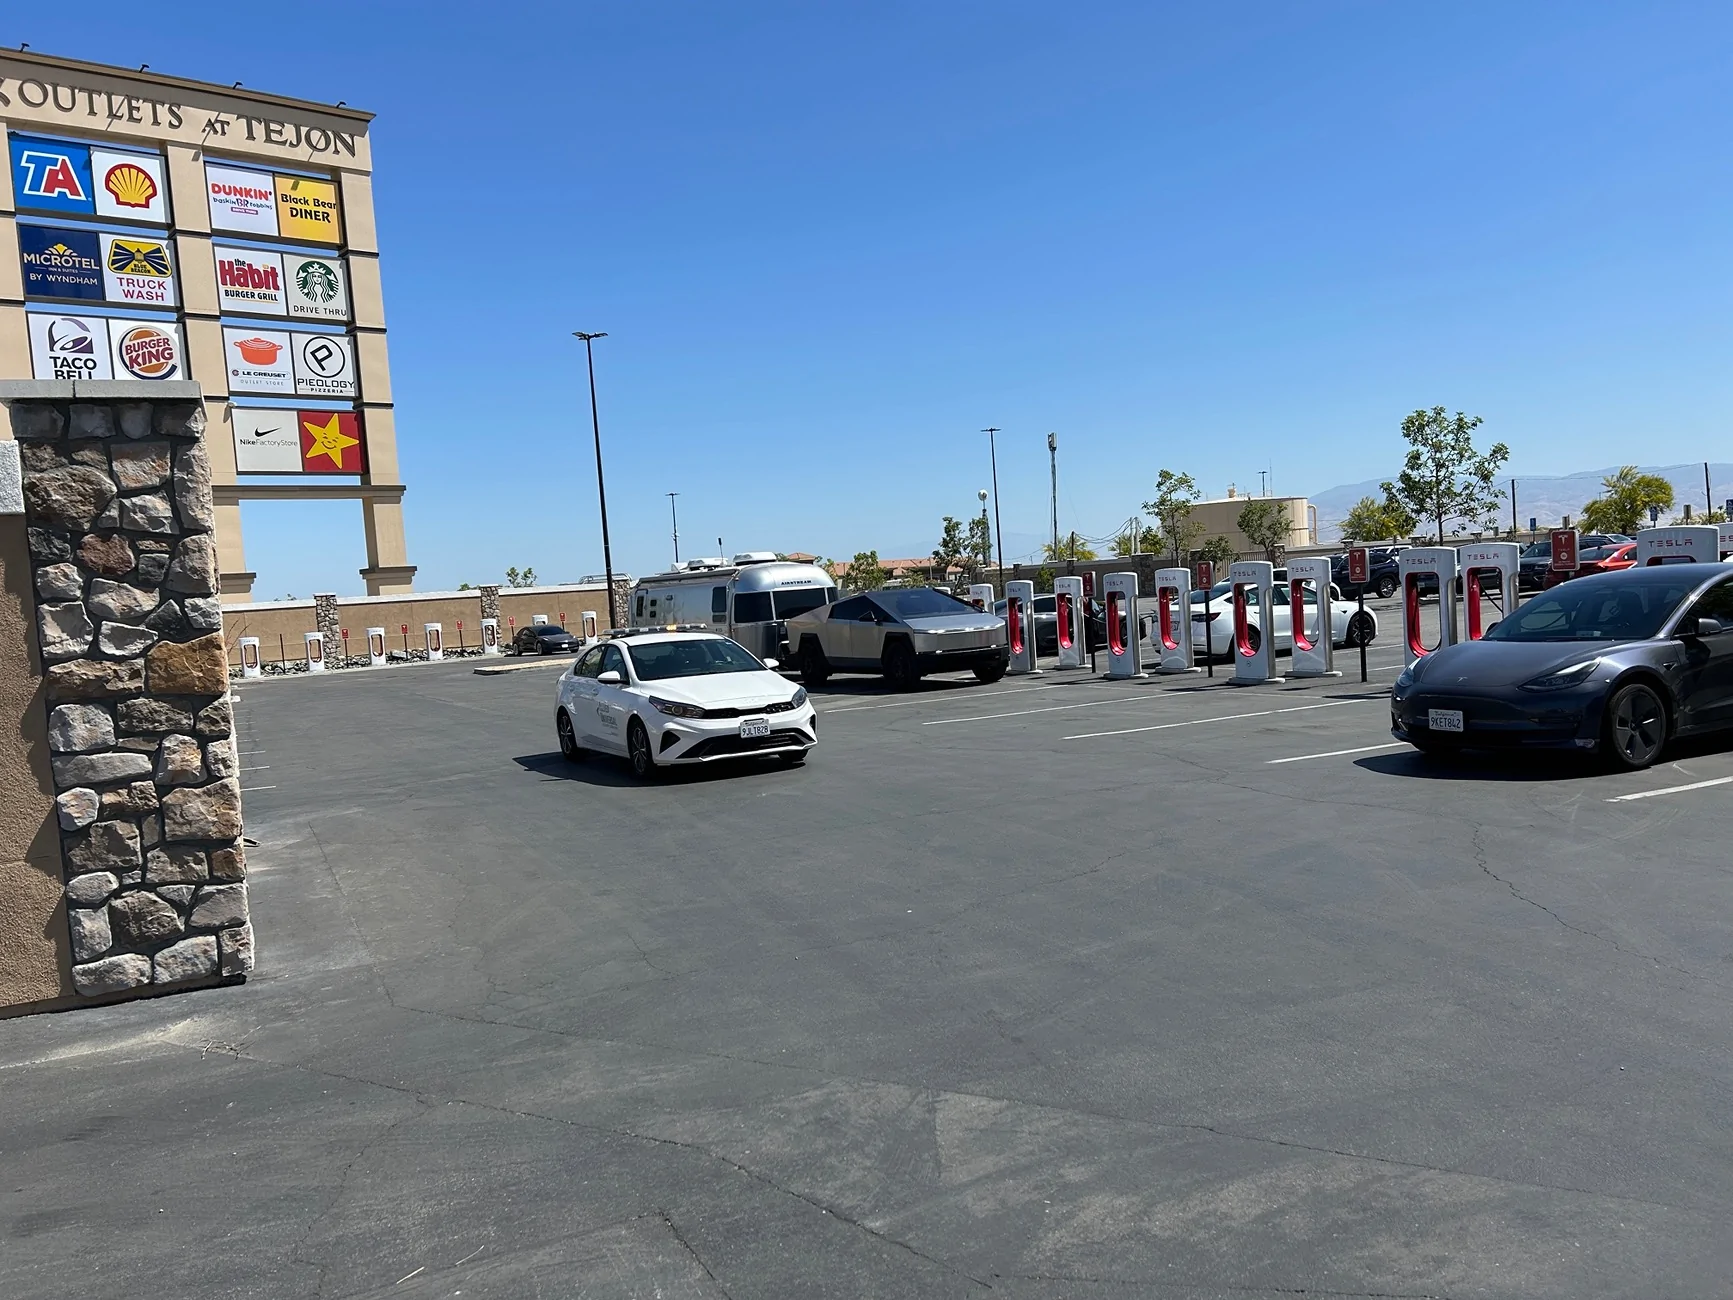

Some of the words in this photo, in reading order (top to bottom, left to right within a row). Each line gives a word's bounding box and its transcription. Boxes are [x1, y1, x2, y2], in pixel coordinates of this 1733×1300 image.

[18, 78, 183, 129] OUTLETS
[201, 118, 230, 136] AT
[236, 114, 356, 158] TEJON
[20, 150, 86, 200] TA
[211, 183, 272, 201] DUNKIN'
[281, 193, 309, 206] Black
[313, 198, 337, 209] Bear
[289, 207, 331, 223] DINER
[24, 252, 100, 270] MICROTEL
[234, 259, 246, 267] the
[29, 273, 42, 281] BY
[46, 274, 98, 285] WYNDHAM
[219, 260, 280, 291] Habit
[116, 277, 167, 290] TRUCK
[122, 289, 164, 301] WASH
[224, 289, 256, 299] BURGER
[258, 292, 278, 301] GRILL
[293, 305, 320, 314] DRIVE
[323, 307, 347, 316] THRU
[125, 337, 171, 355] BURGER
[49, 356, 97, 370] TACO
[128, 347, 174, 370] KING
[297, 378, 355, 388] PIEOLOGY
[1648, 538, 1693, 548] TESLA
[1430, 716, 1461, 729] 9KET842
